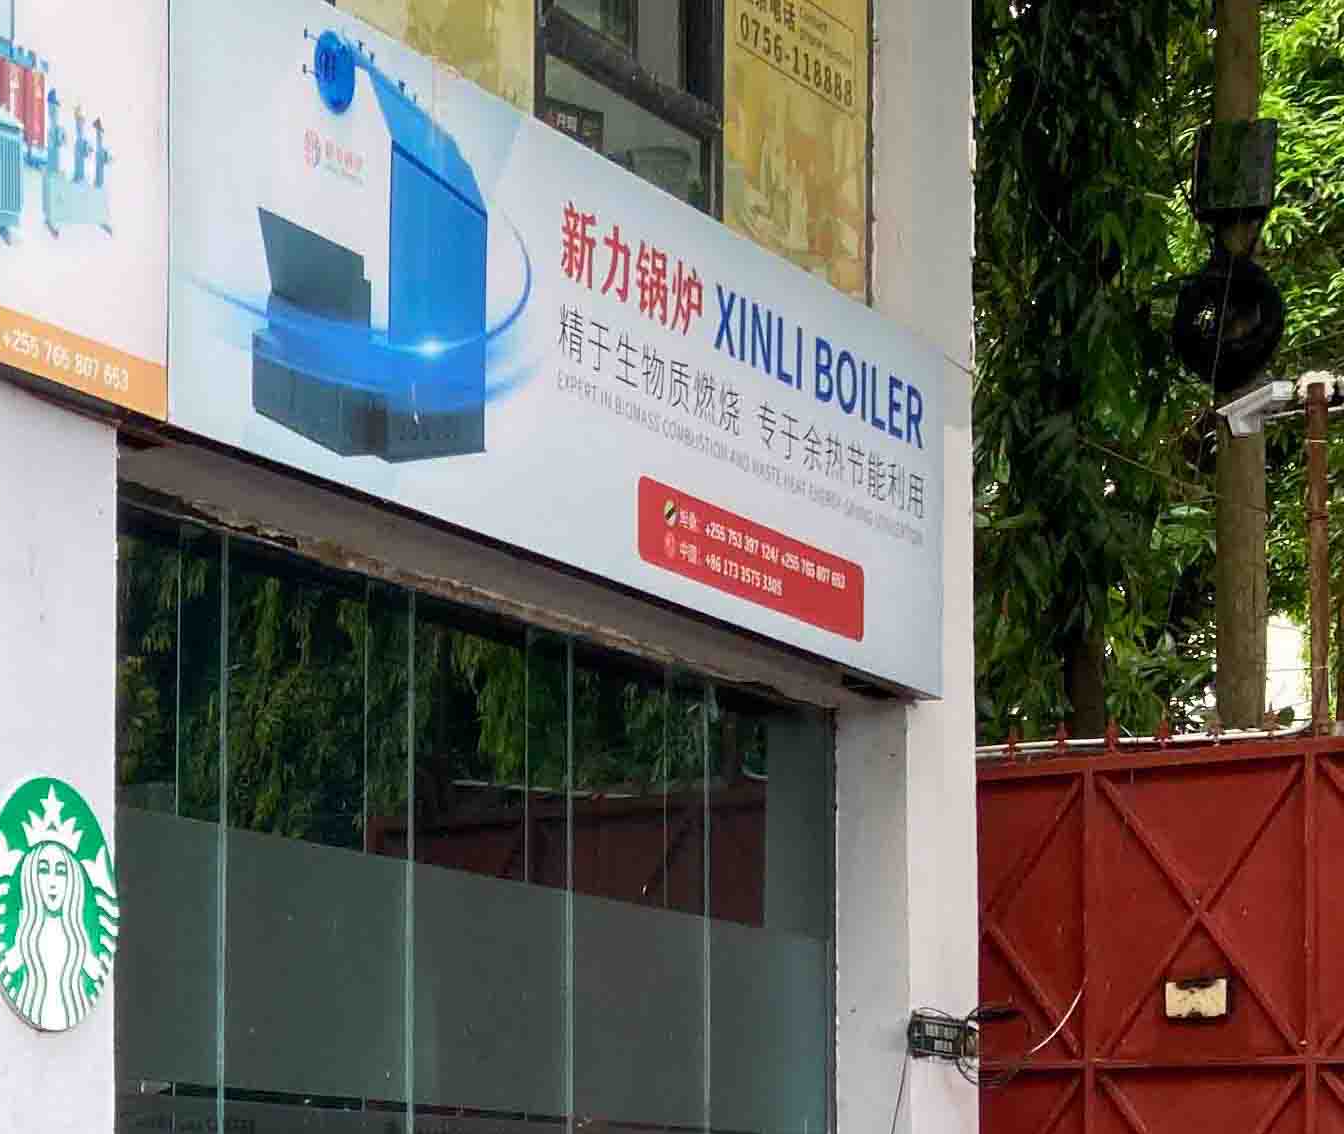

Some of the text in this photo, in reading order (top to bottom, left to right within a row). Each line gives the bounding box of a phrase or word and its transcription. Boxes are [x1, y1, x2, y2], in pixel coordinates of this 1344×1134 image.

[740, 12, 852, 106] 0756-118888
[561, 201, 923, 449] 新力锅炉 XINLI BOILER
[558, 303, 924, 519] 精于生物质燃烧 专于余热节能利用
[703, 522, 726, 542] +255
